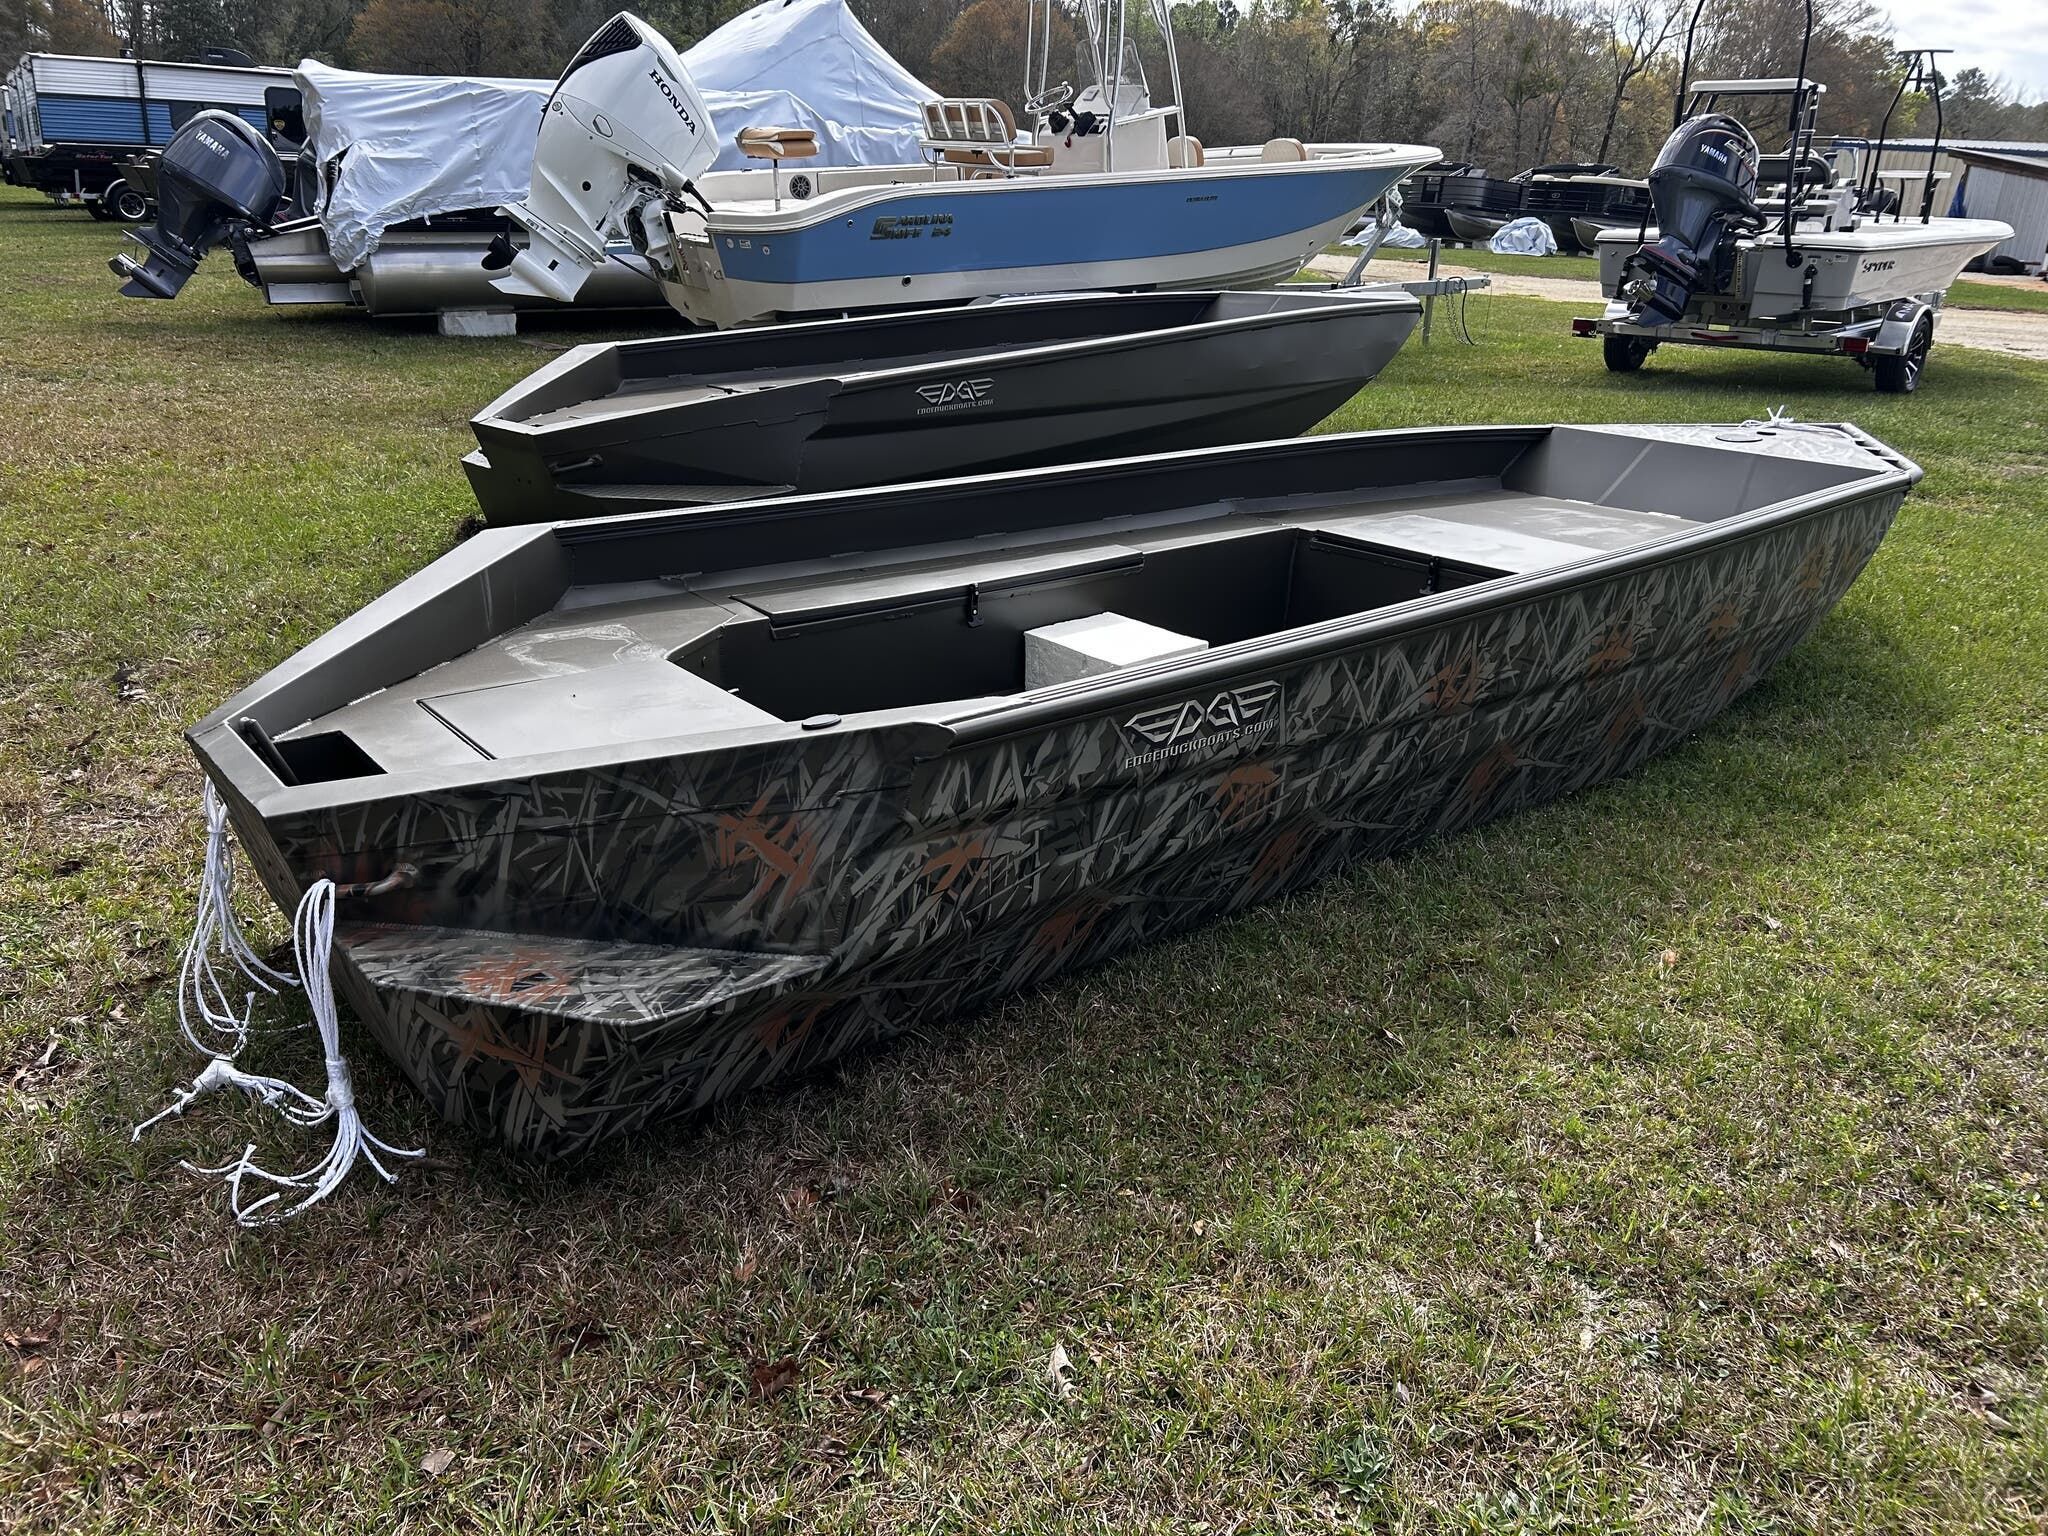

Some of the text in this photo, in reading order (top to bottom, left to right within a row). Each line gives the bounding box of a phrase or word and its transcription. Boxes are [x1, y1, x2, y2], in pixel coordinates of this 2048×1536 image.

[648, 68, 696, 136] HONDA
[195, 130, 230, 160] YAMAHA
[1700, 143, 1728, 165] YAMAHA
[915, 378, 995, 405] EDGE
[1123, 680, 1282, 745] EDGE
[1125, 719, 1275, 769] EDGEDUCKBOATS.COM
